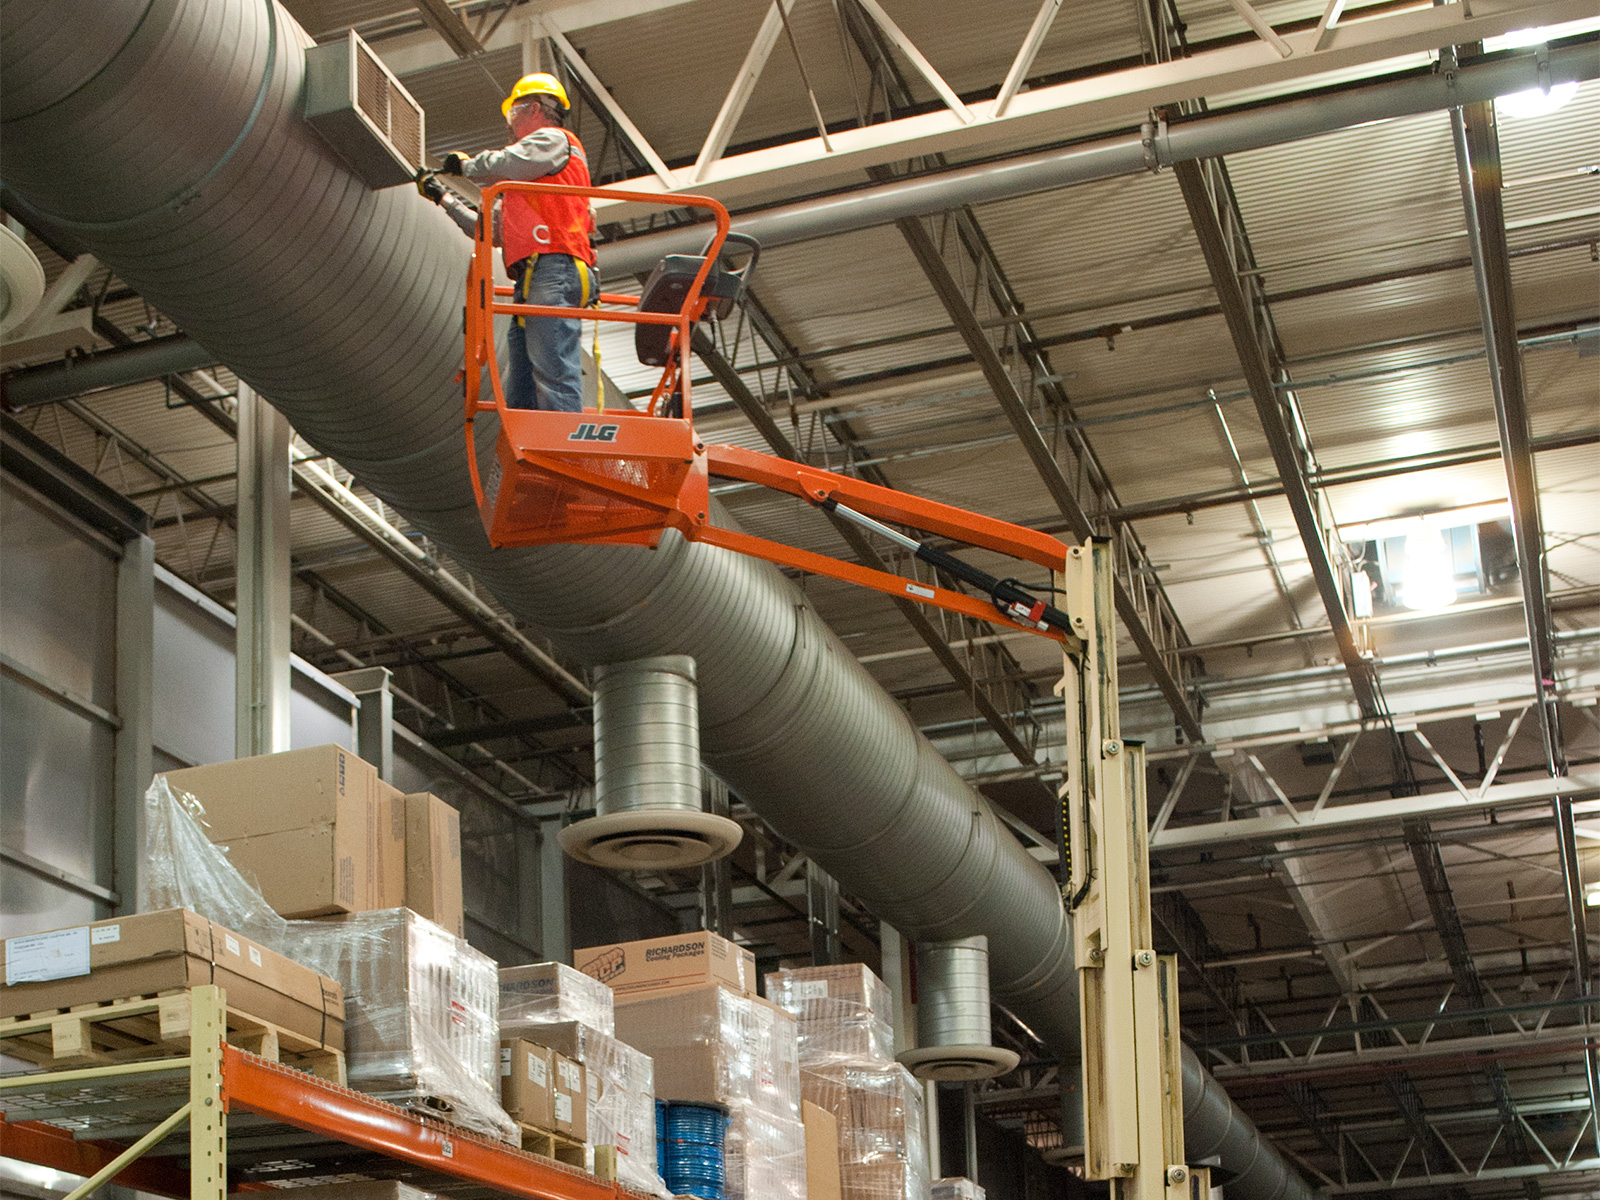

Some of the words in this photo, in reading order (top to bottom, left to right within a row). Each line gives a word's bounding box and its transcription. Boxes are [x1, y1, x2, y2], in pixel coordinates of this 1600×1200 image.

[568, 423, 619, 442] JLG
[646, 942, 705, 956] RICHARDSON
[646, 954, 671, 962] Cooling
[672, 950, 705, 958] Packages
